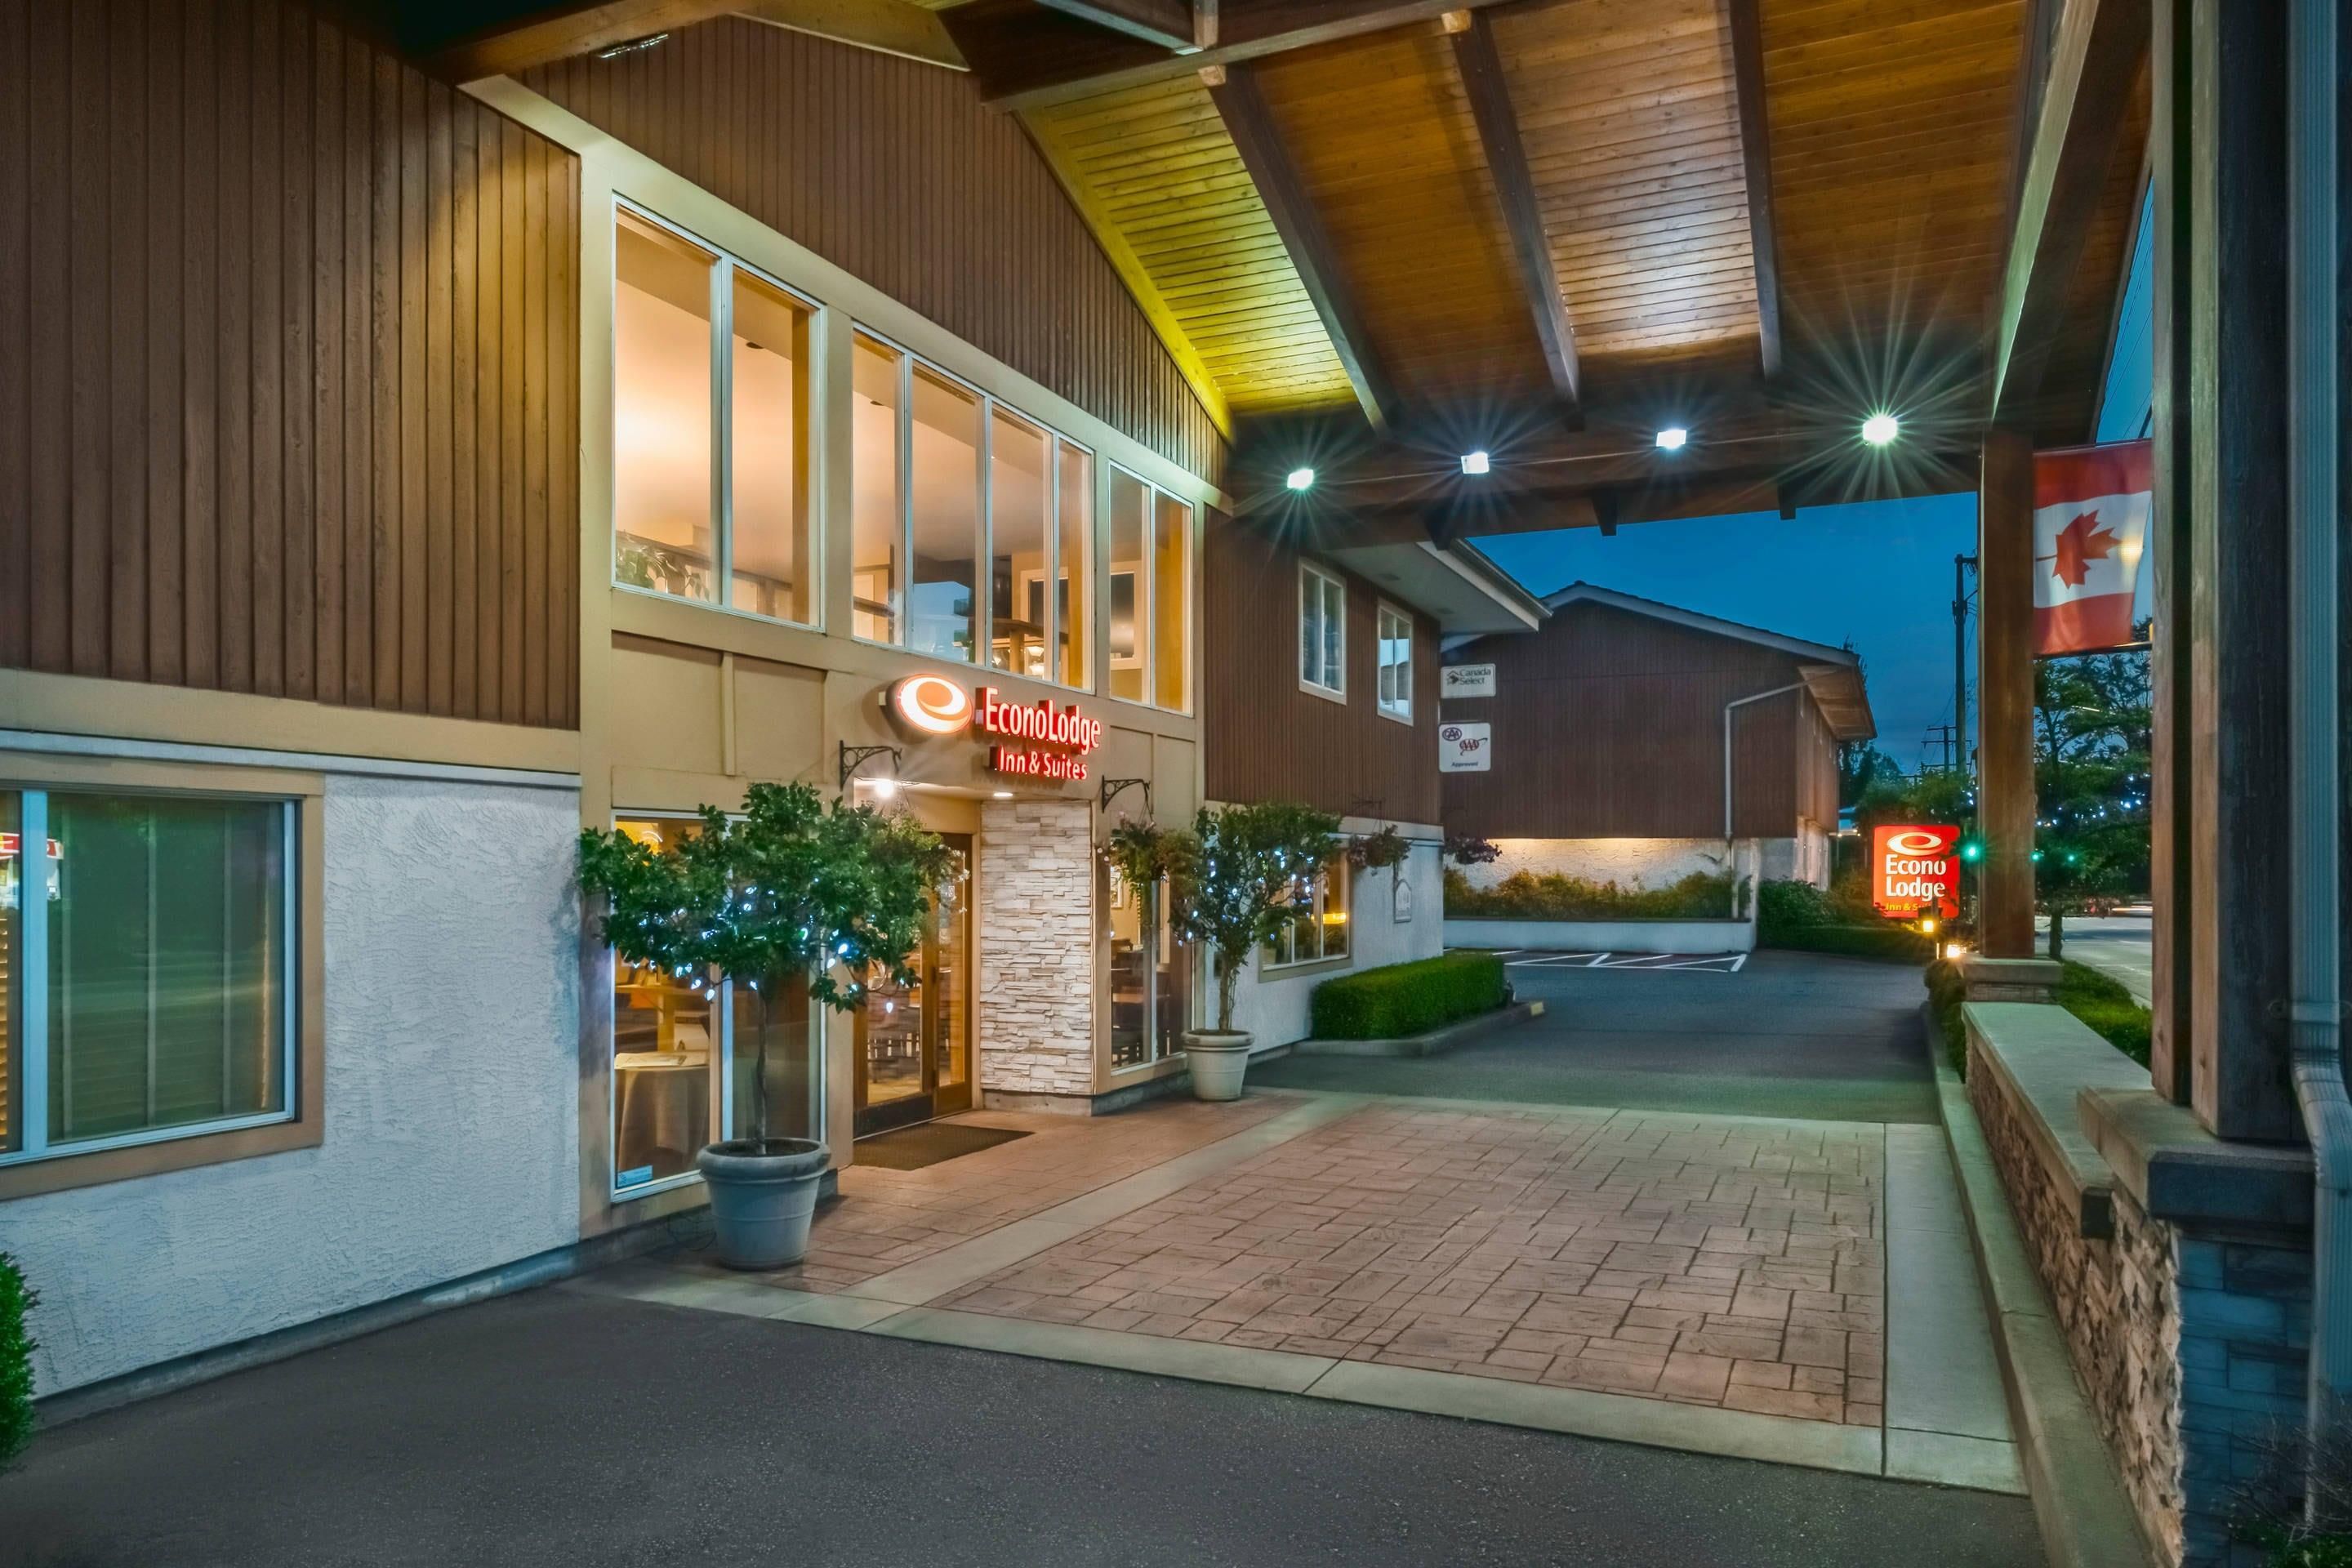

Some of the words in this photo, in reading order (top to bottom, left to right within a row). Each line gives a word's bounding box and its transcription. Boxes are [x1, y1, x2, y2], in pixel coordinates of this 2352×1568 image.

[1459, 667, 1491, 677] Canada
[1459, 677, 1485, 685] Select
[985, 686, 1102, 756] EconoLodge
[1000, 744, 1026, 773] Inn
[1030, 751, 1040, 775] &
[1043, 750, 1088, 780] Suites
[1885, 853, 1947, 875] Econo
[1886, 875, 1945, 902] Lodge
[1886, 902, 1902, 911] Inn
[1903, 902, 1911, 911] &
